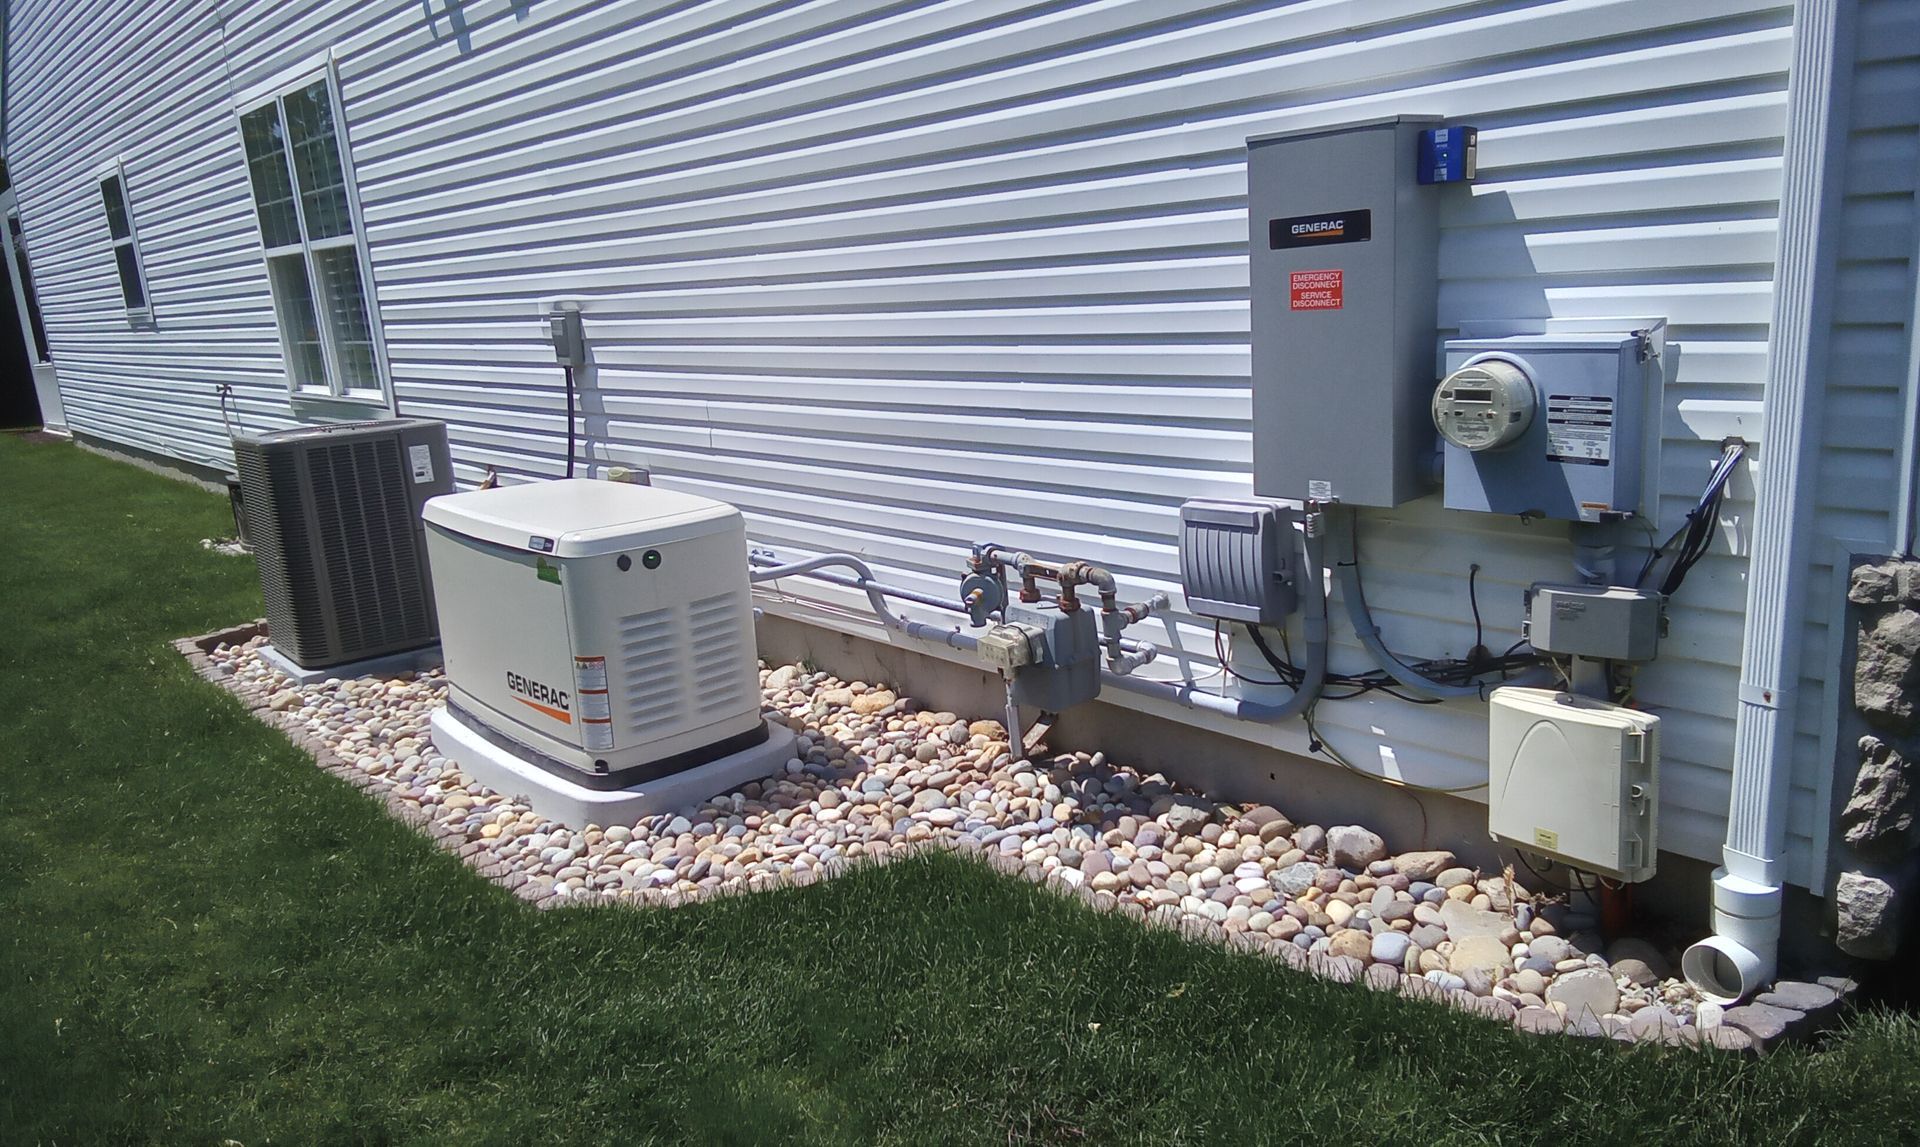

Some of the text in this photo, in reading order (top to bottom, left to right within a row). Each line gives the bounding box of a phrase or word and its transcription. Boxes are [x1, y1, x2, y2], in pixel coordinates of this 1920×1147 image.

[1291, 220, 1344, 234] GENERAC
[1292, 272, 1340, 282] EMERGENCY
[1292, 280, 1341, 290] DISCONNECT
[1300, 291, 1332, 300] SERVICE
[1292, 299, 1341, 308] DISCONNECT
[507, 671, 569, 710] GENERAC
